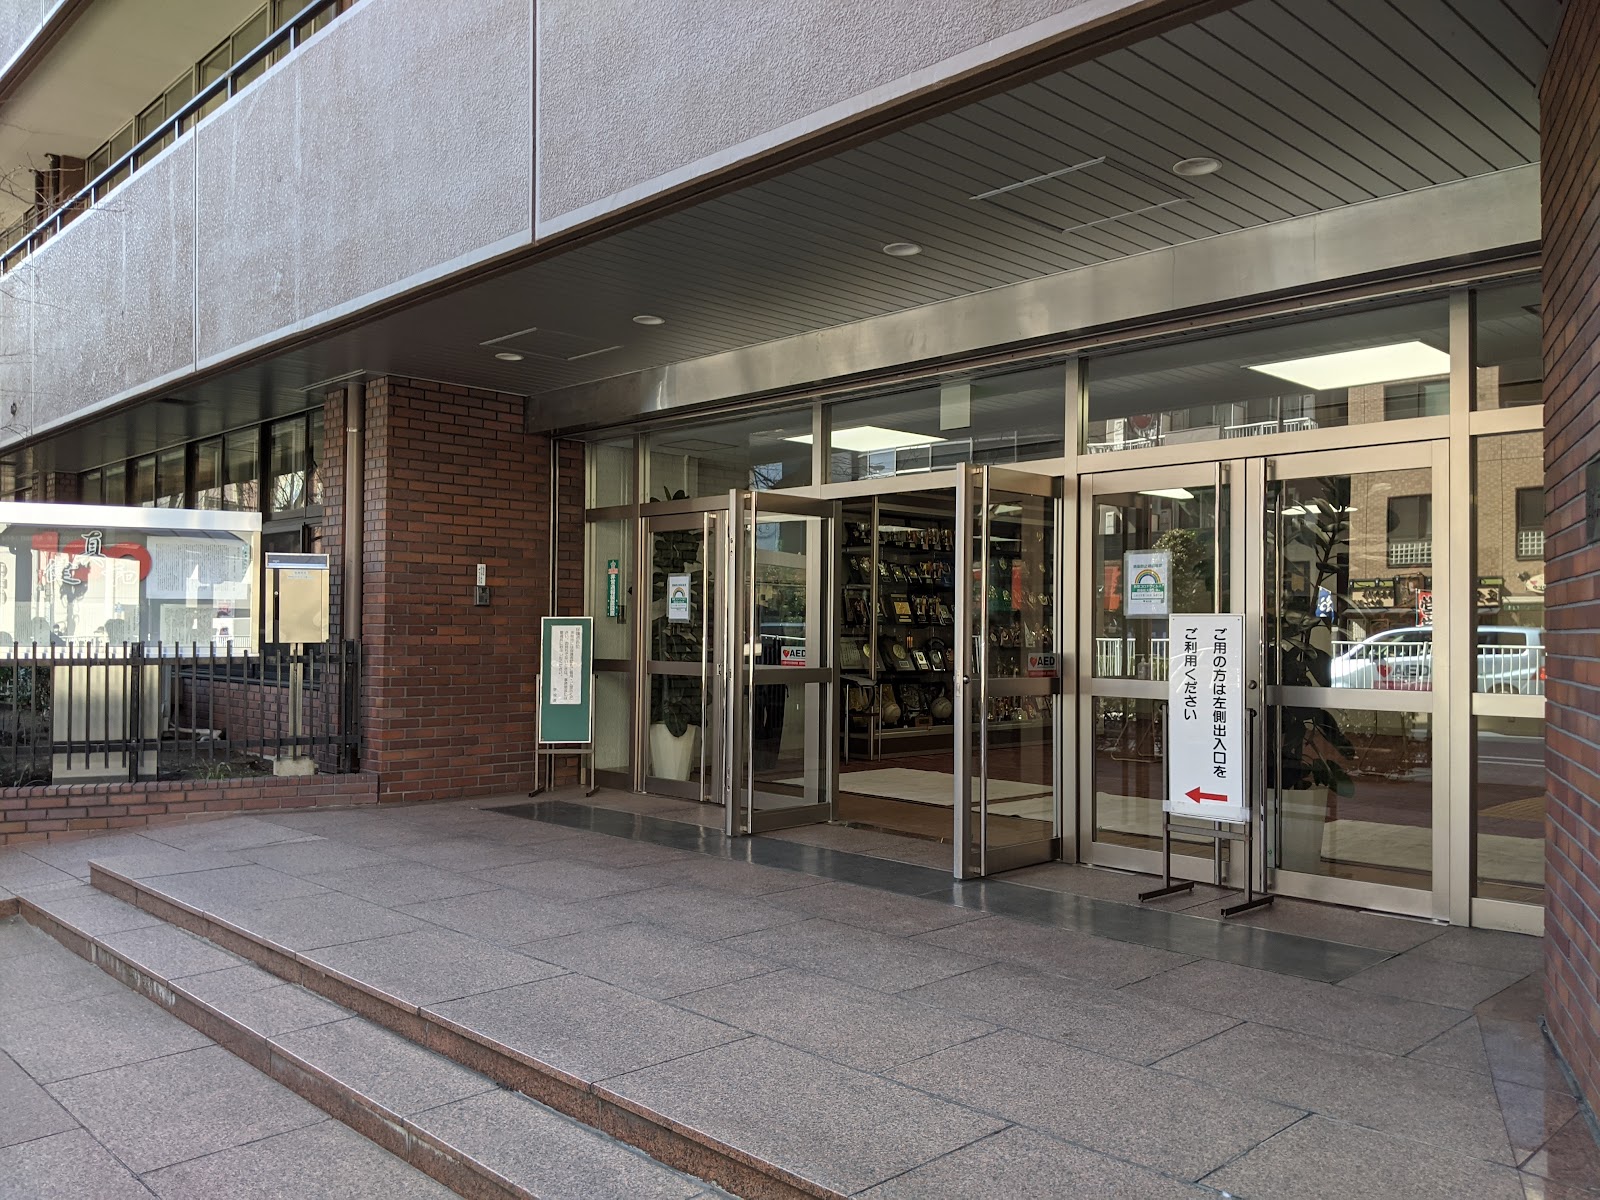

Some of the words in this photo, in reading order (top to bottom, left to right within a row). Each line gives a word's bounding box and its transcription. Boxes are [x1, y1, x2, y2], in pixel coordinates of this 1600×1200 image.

[1037, 656, 1056, 666] AED
[1183, 627, 1198, 721] ご利用ください
[1392, 664, 1431, 677] AED
[1212, 627, 1228, 779] ご用の方は左側出入口を
